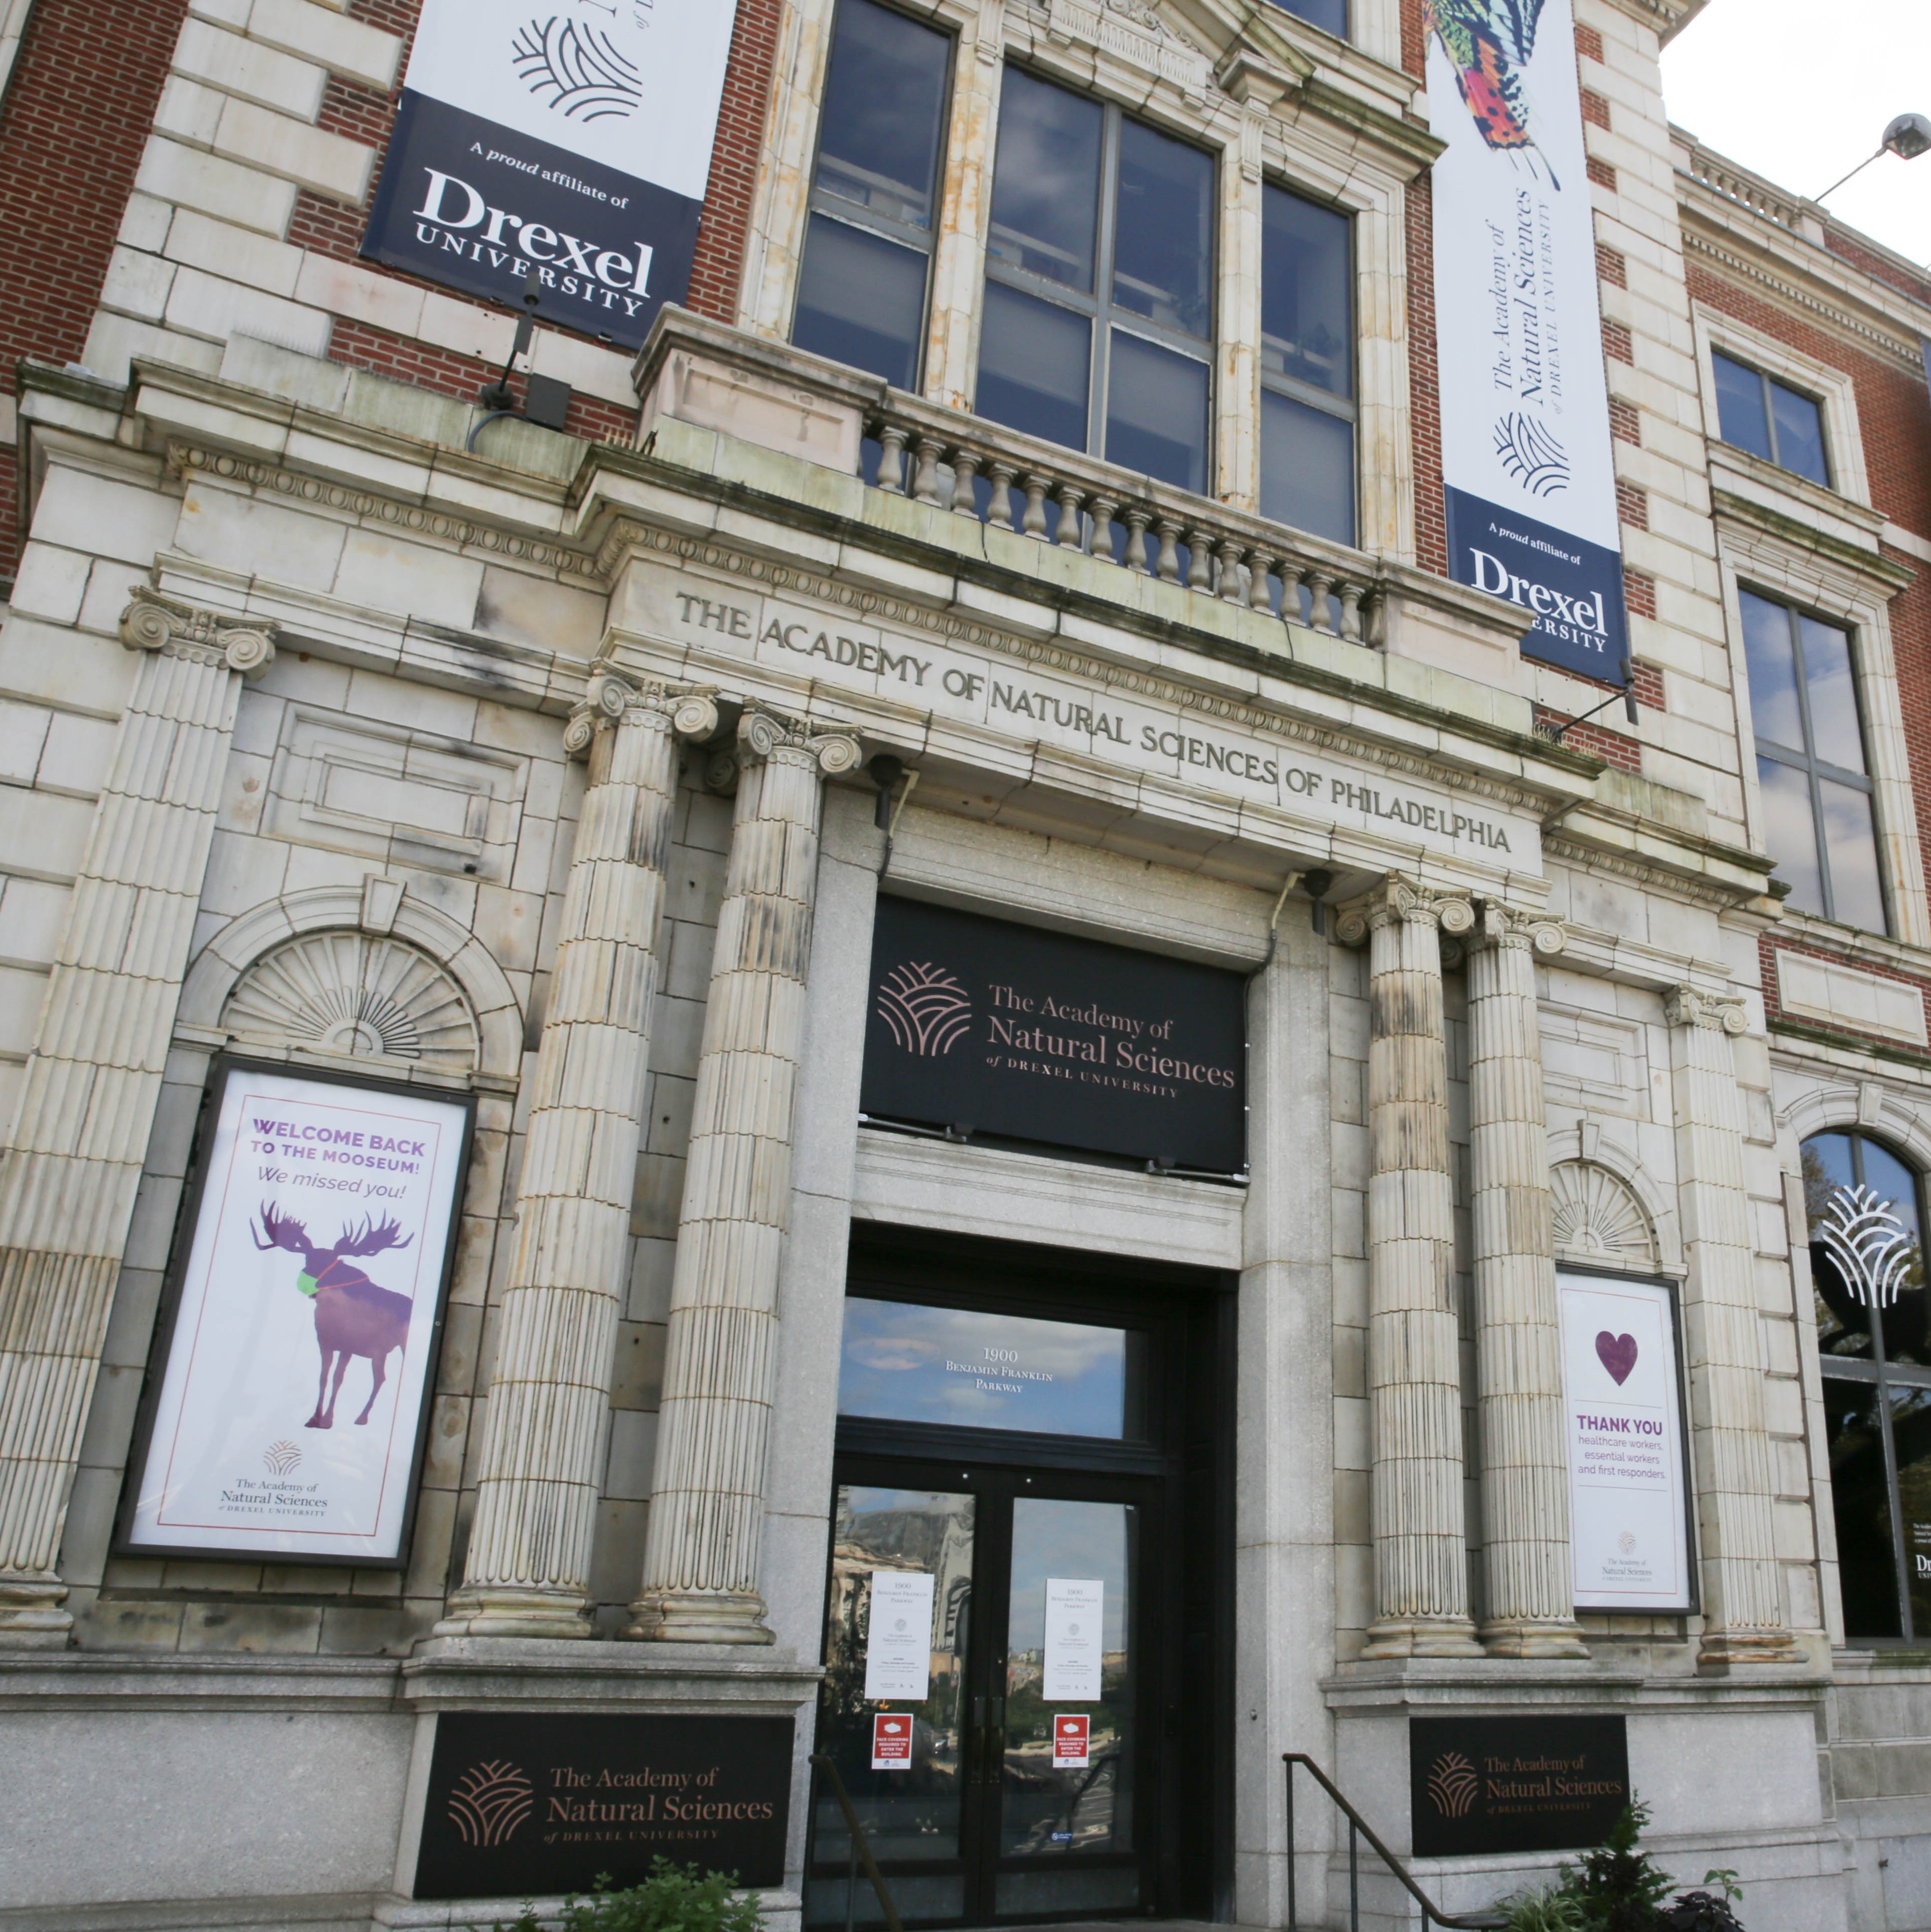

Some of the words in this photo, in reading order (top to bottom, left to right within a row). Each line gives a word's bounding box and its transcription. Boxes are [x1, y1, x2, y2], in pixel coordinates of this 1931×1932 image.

[470, 142, 482, 154] A
[487, 147, 539, 175] proud
[542, 168, 606, 201] affiliate
[611, 196, 629, 209] of
[412, 167, 653, 298] Drexel
[1485, 219, 1505, 247] of
[1512, 188, 1536, 295] Sciences
[415, 222, 643, 316] UNIVERSITY
[1539, 200, 1556, 312] UNIVERSITY
[1489, 249, 1512, 347] Academy
[1514, 298, 1543, 406] Natural
[1546, 321, 1562, 397] DREXEL
[1492, 351, 1512, 391] The
[1489, 523, 1497, 532] A
[1499, 526, 1528, 544] proud
[1531, 539, 1568, 560] affiliate
[1571, 556, 1581, 565] of
[1469, 547, 1608, 636] Drexel
[1531, 616, 1606, 653] ERSITY
[676, 592, 752, 640] THE
[761, 618, 933, 686] ACADEMY
[943, 668, 985, 700] OF
[991, 681, 1131, 746] NATURAL
[1140, 725, 1278, 785] SCIENCES
[1286, 768, 1322, 797] OF
[1331, 779, 1512, 853] PHILADELPHIA
[989, 985, 1034, 1013] The
[1040, 996, 1144, 1039] Academy
[1150, 1020, 1173, 1040] of
[987, 1015, 1107, 1066] Natural
[1116, 1041, 1235, 1089] Sciences
[986, 1056, 1002, 1067] of
[1008, 1058, 1073, 1079] DREXEL
[1080, 1072, 1179, 1097] UNIVERSITY
[253, 1118, 364, 1147] WELCOME
[369, 1135, 426, 1157] BACK
[251, 1140, 275, 1154] TO
[282, 1144, 316, 1160] THE
[323, 1150, 419, 1174] MOOSEUM!
[259, 1166, 288, 1183] We
[292, 1173, 363, 1193] missed
[364, 1183, 406, 1199] you!
[946, 1360, 997, 1376] BENJAMIN
[1001, 1366, 1053, 1382] FRANKLIN
[982, 1347, 1018, 1363] 1900
[976, 1378, 1023, 1393] PARKWAY
[1576, 1415, 1631, 1433] THANK
[1633, 1419, 1662, 1435] YOU
[1578, 1434, 1627, 1447] healthcare
[1578, 1465, 1596, 1474] and
[1599, 1465, 1615, 1475] first
[1618, 1469, 1666, 1479] responders.
[1585, 1451, 1625, 1461] essential
[1627, 1454, 1659, 1464] workers
[220, 1490, 271, 1504] Natural
[275, 1494, 328, 1507] Sciences
[236, 1479, 256, 1489] The
[259, 1481, 304, 1494] Academy
[306, 1484, 319, 1492] of
[227, 1505, 264, 1513] DREXEL
[269, 1508, 326, 1517] UNIVERSITY
[1602, 1567, 1626, 1575] Natural
[1627, 1567, 1652, 1575] Sciences
[550, 1766, 591, 1788] The
[596, 1767, 691, 1792] Academy
[696, 1766, 720, 1788] of
[1484, 1756, 1509, 1773] The
[1513, 1755, 1569, 1774] Academy
[1572, 1754, 1585, 1769] of
[1486, 1777, 1551, 1799] Natural
[1555, 1776, 1622, 1796] Sciences
[546, 1795, 654, 1823] Natural
[662, 1795, 773, 1821] Sciences
[1498, 1805, 1533, 1814] DREXEL
[1537, 1803, 1591, 1812] UNIVERSITY
[544, 1831, 558, 1844] of
[562, 1831, 623, 1842] DREXEL
[629, 1828, 719, 1840] UNIVERSITY
